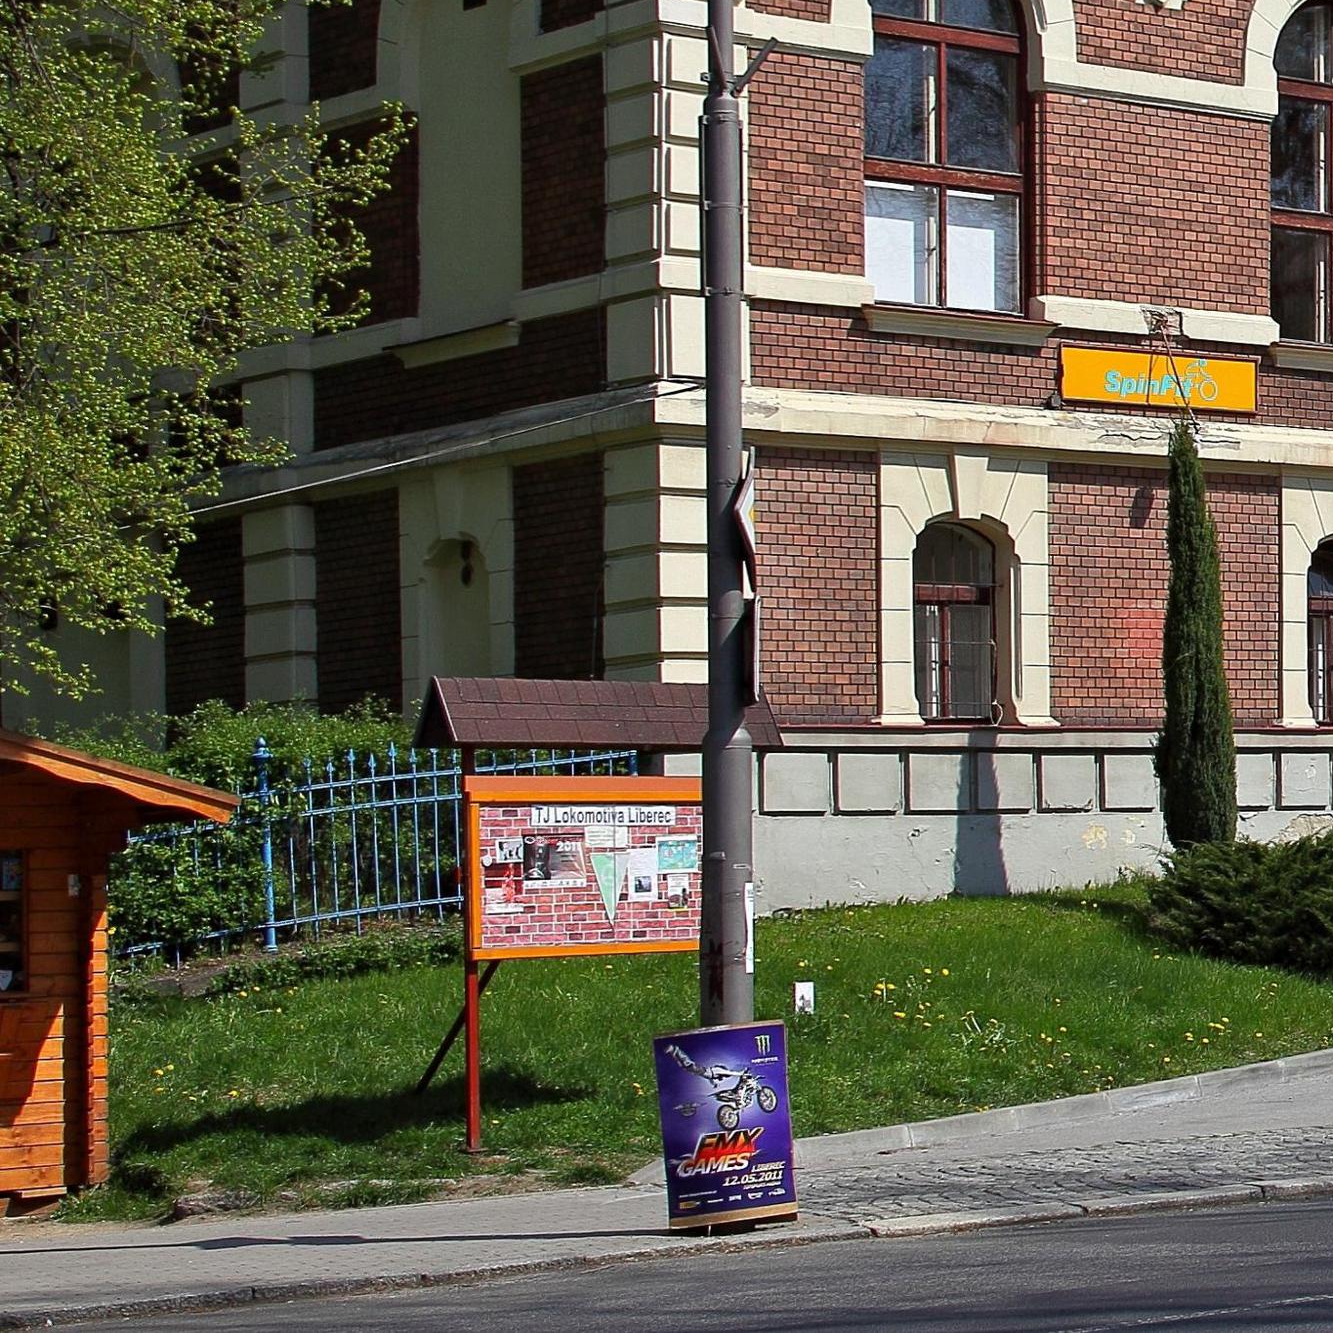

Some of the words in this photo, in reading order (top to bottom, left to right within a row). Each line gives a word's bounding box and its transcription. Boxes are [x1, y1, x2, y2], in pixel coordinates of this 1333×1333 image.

[1104, 369, 1193, 399] SpinFit
[535, 807, 550, 824] TJ
[554, 807, 625, 824] Lokomotiva
[628, 808, 672, 824] Liberec
[694, 1127, 764, 1157] FMX
[677, 1152, 752, 1178] GAMES
[722, 1170, 783, 1187] 12.05.2011
